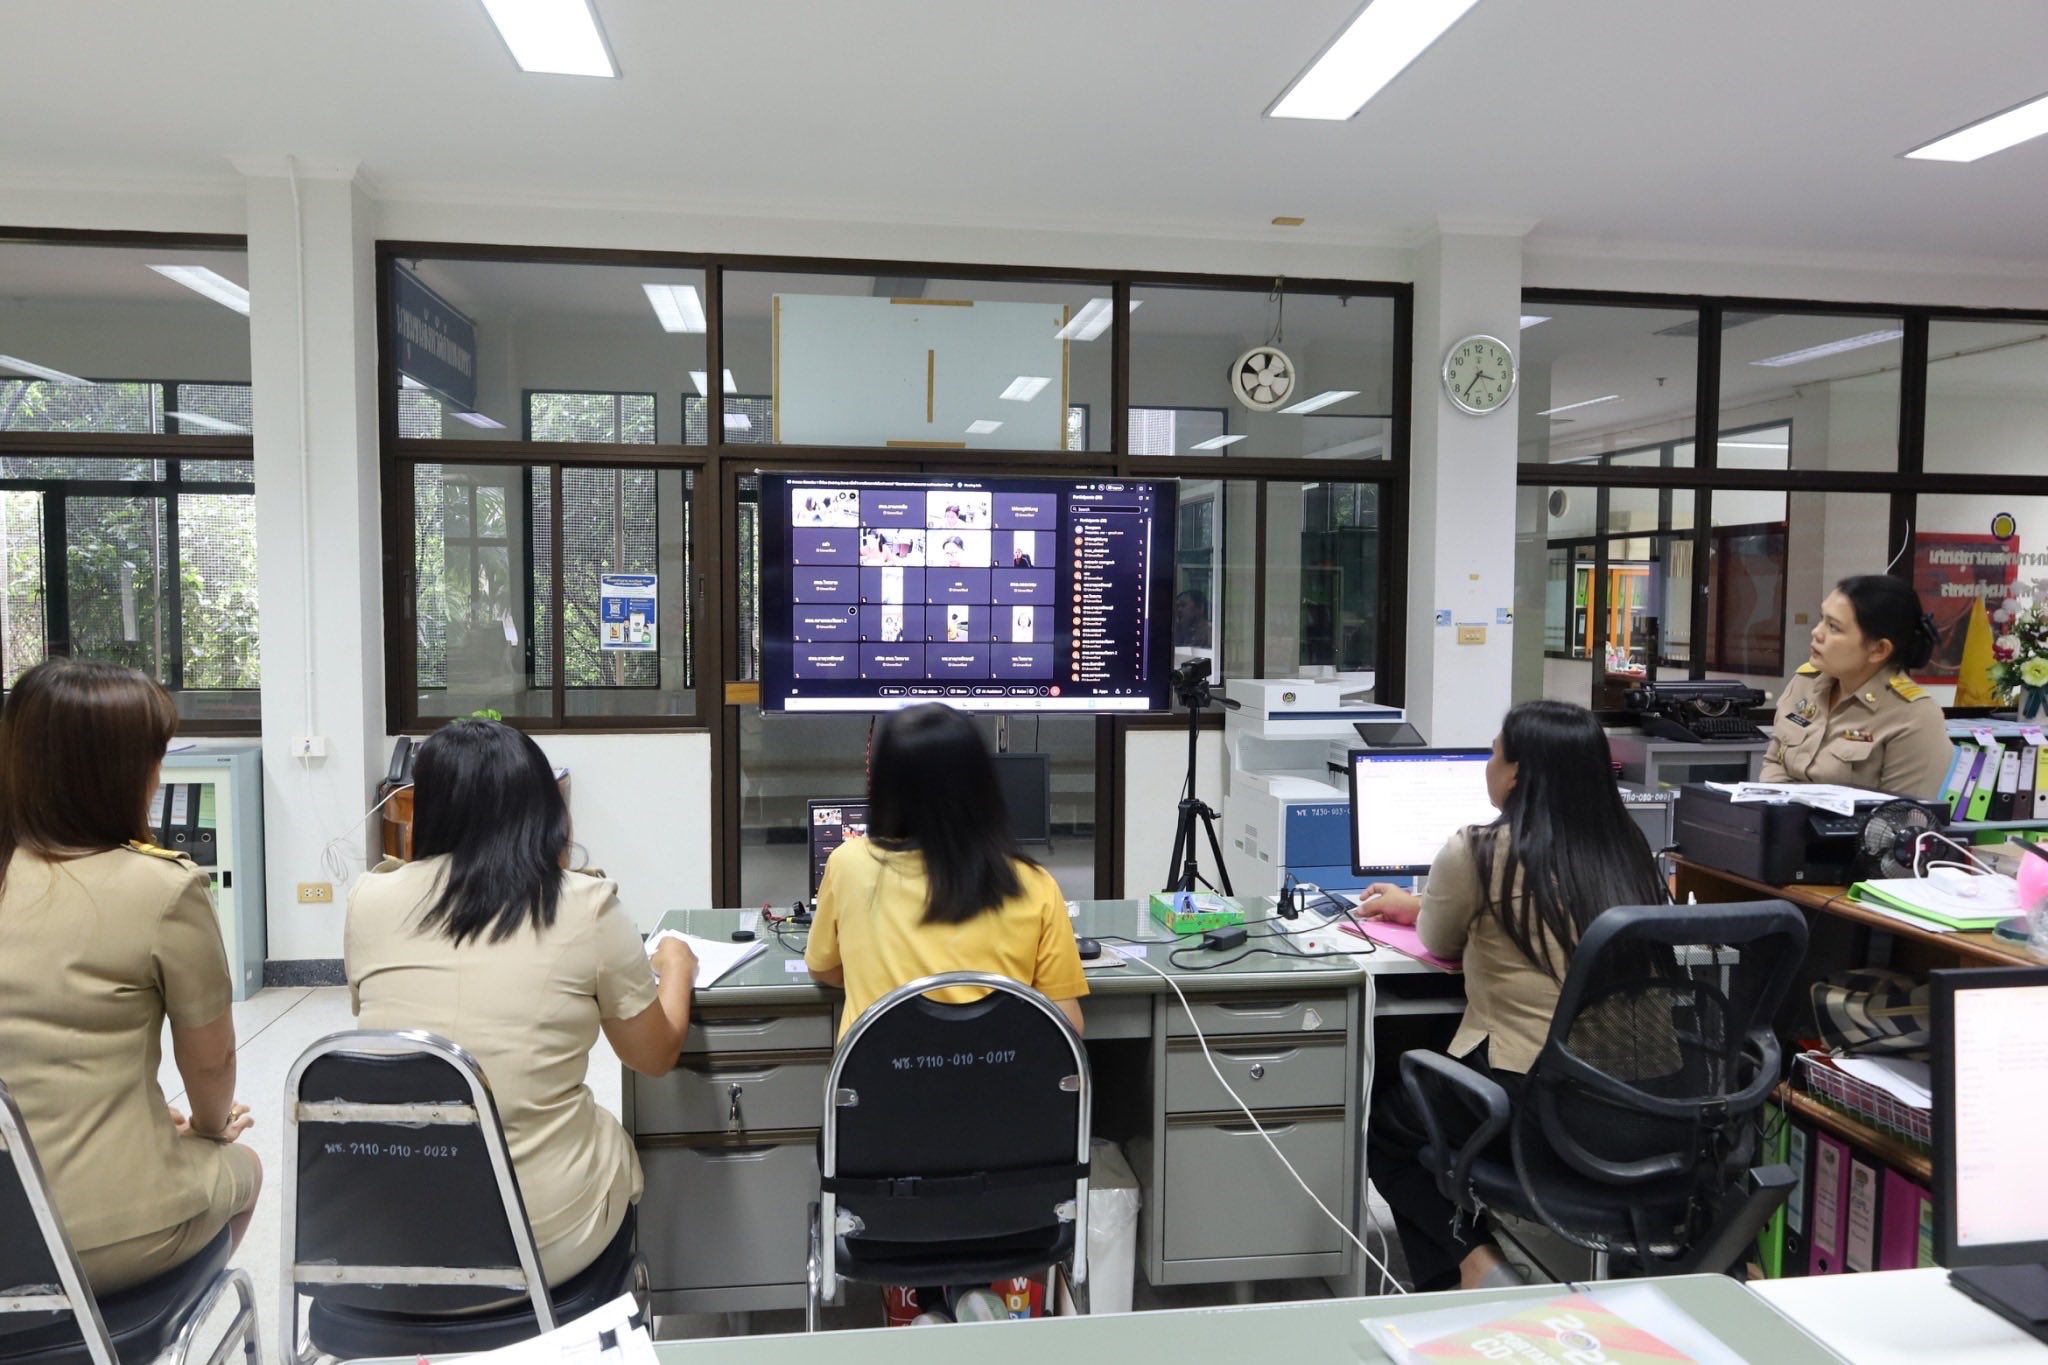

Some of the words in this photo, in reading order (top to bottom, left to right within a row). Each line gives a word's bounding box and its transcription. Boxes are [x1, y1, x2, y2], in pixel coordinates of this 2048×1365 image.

[1463, 348, 1470, 358] 11
[1475, 344, 1484, 354] 12
[1490, 348, 1494, 358] 1
[1455, 357, 1464, 366] 10
[1497, 357, 1503, 366] 2
[1450, 370, 1456, 379] 9
[1501, 370, 1507, 379] 3
[1454, 383, 1461, 393] 8
[1497, 384, 1502, 392] 4
[1475, 396, 1482, 406] 6
[1487, 392, 1494, 402] 5
